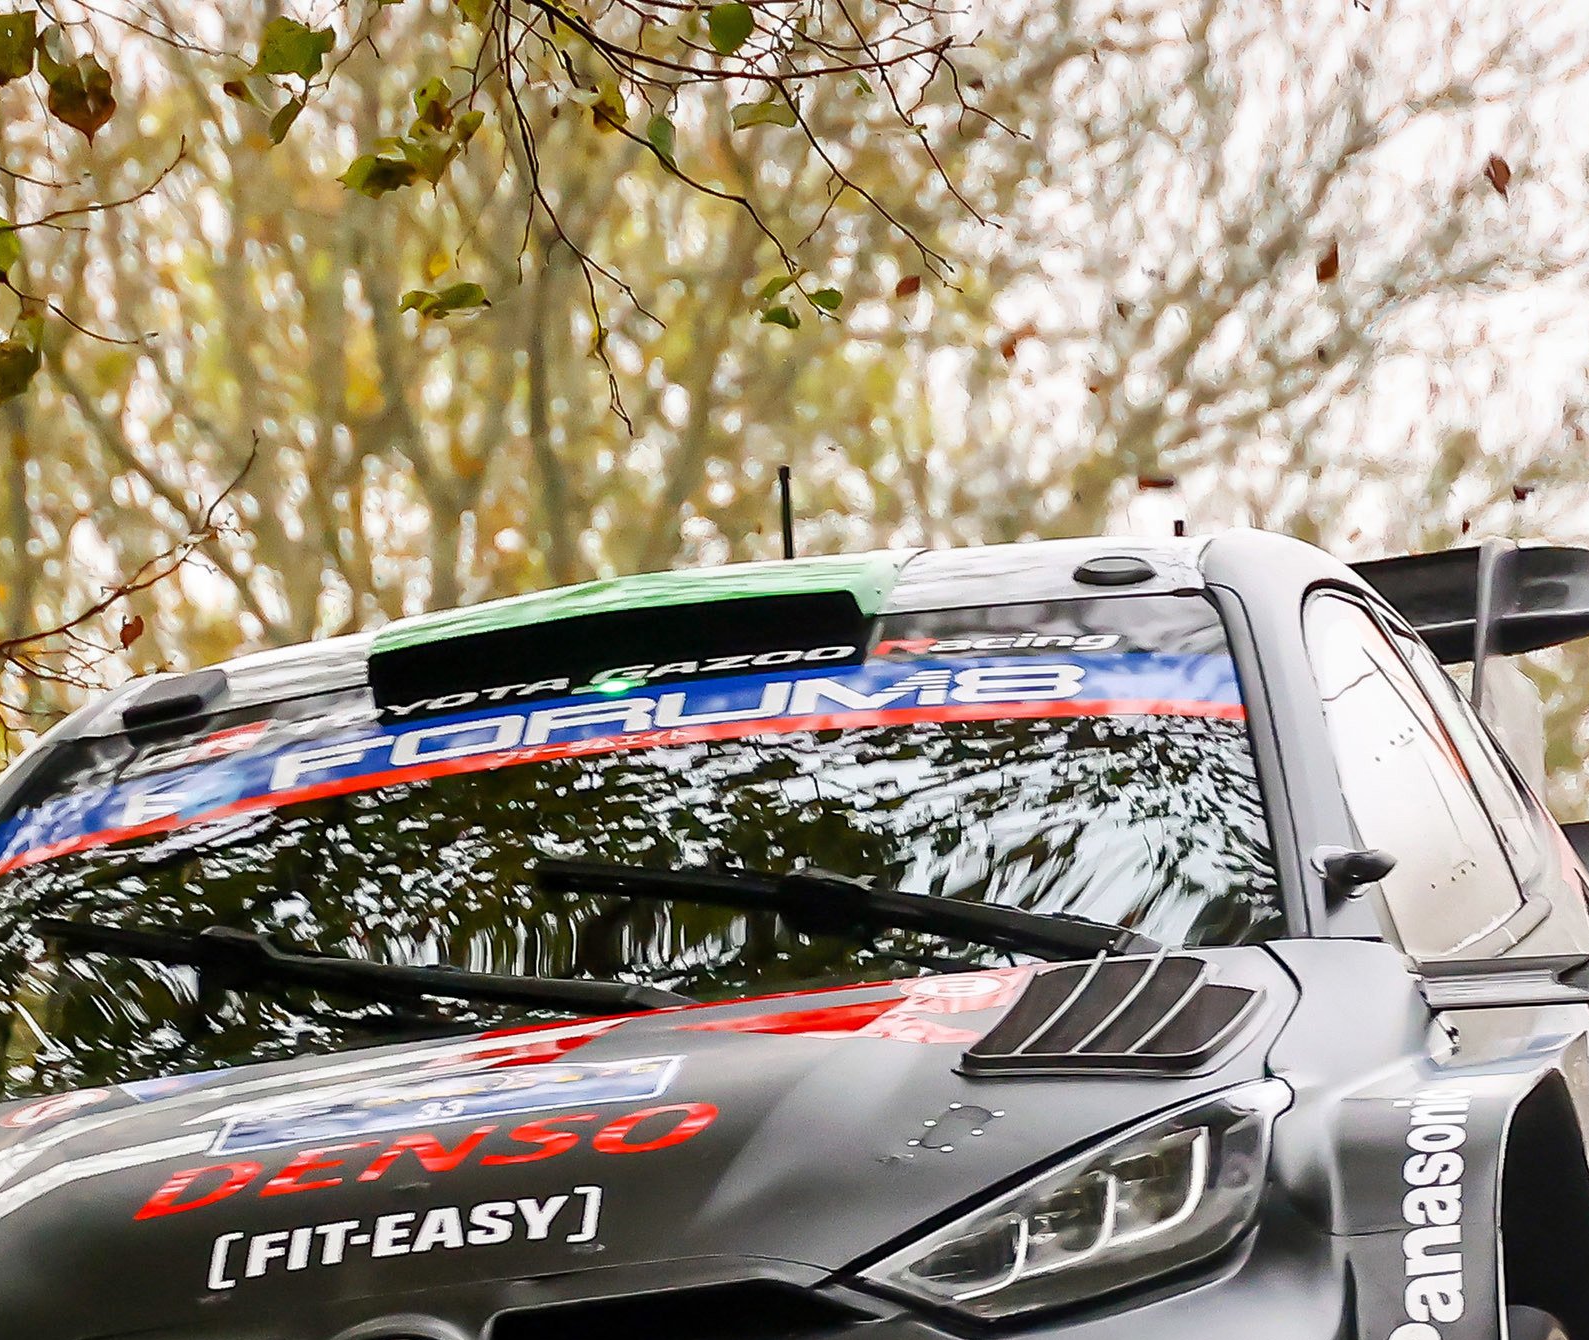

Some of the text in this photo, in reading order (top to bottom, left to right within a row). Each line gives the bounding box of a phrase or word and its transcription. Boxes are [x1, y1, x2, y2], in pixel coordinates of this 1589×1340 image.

[572, 646, 856, 693] GAZOO
[873, 632, 1122, 656] Racing
[270, 662, 1086, 791] FORUM8
[134, 1102, 718, 1220] DENSO
